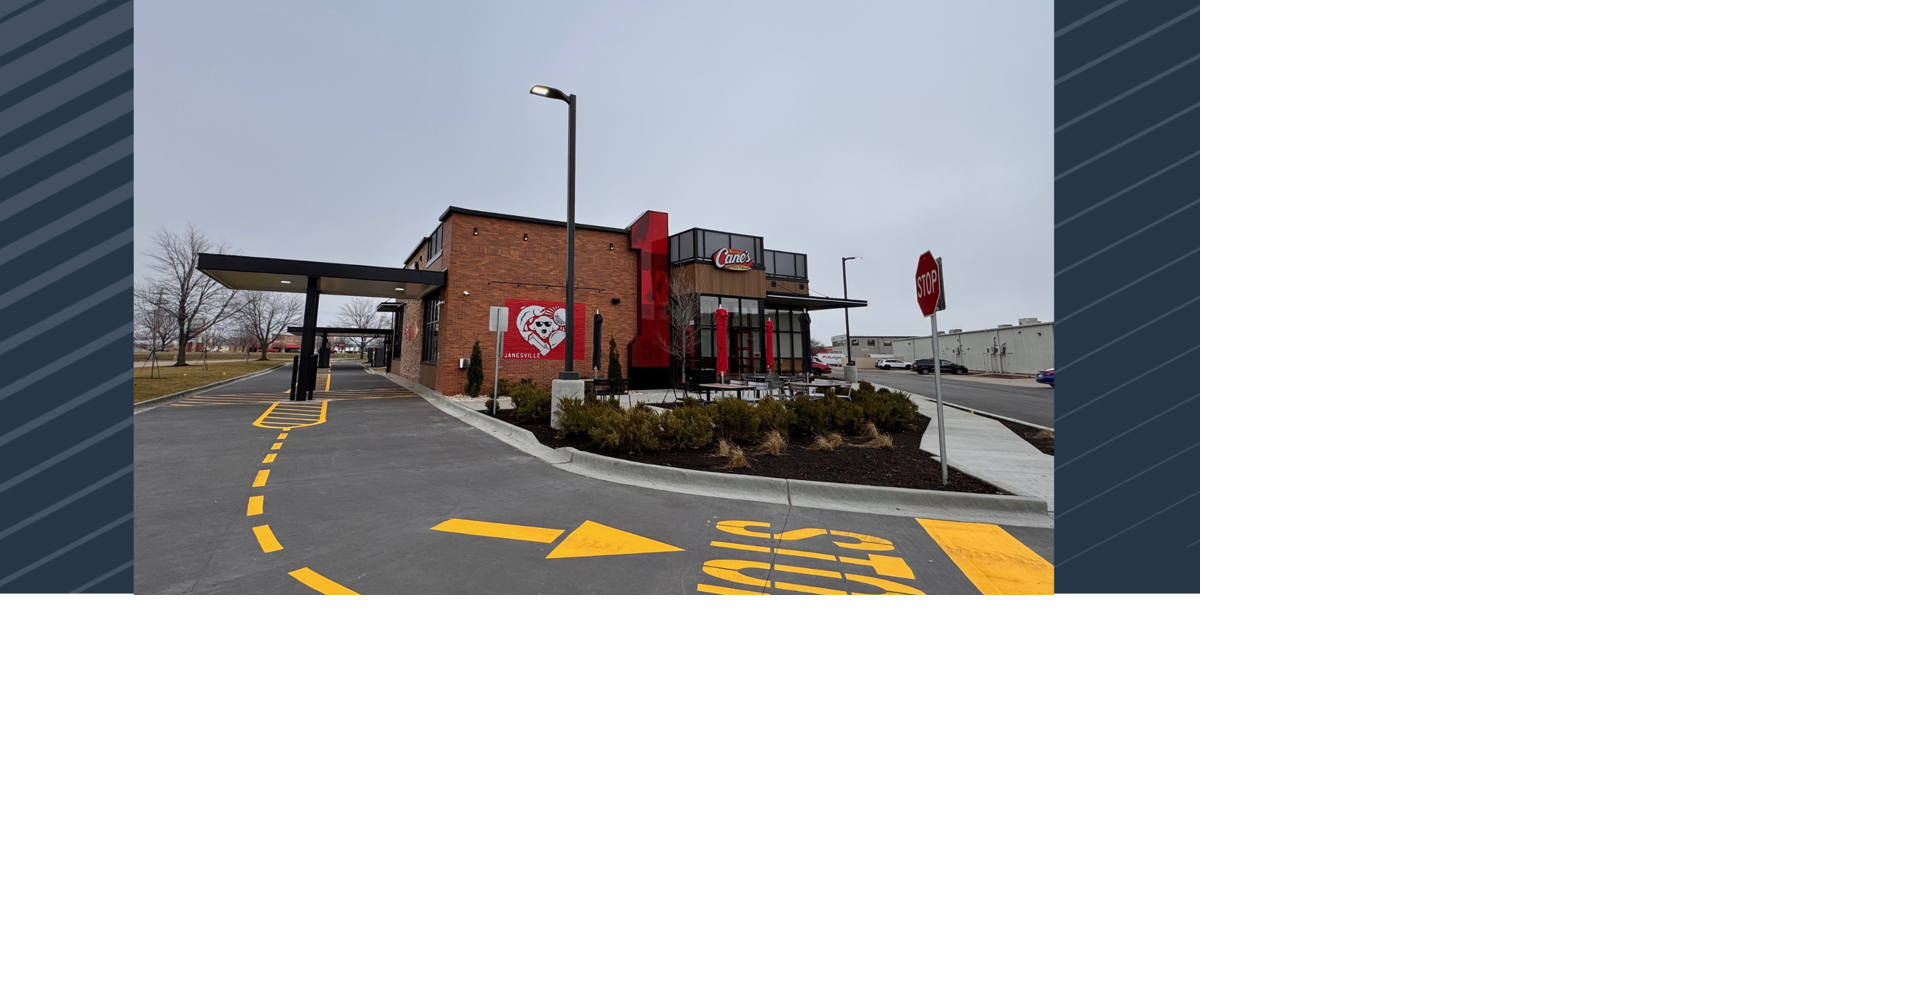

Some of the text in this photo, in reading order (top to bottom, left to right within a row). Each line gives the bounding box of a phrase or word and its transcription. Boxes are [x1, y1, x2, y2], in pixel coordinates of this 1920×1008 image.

[716, 248, 752, 268] Cane's
[917, 269, 938, 298] STOP
[697, 520, 927, 595] STO
